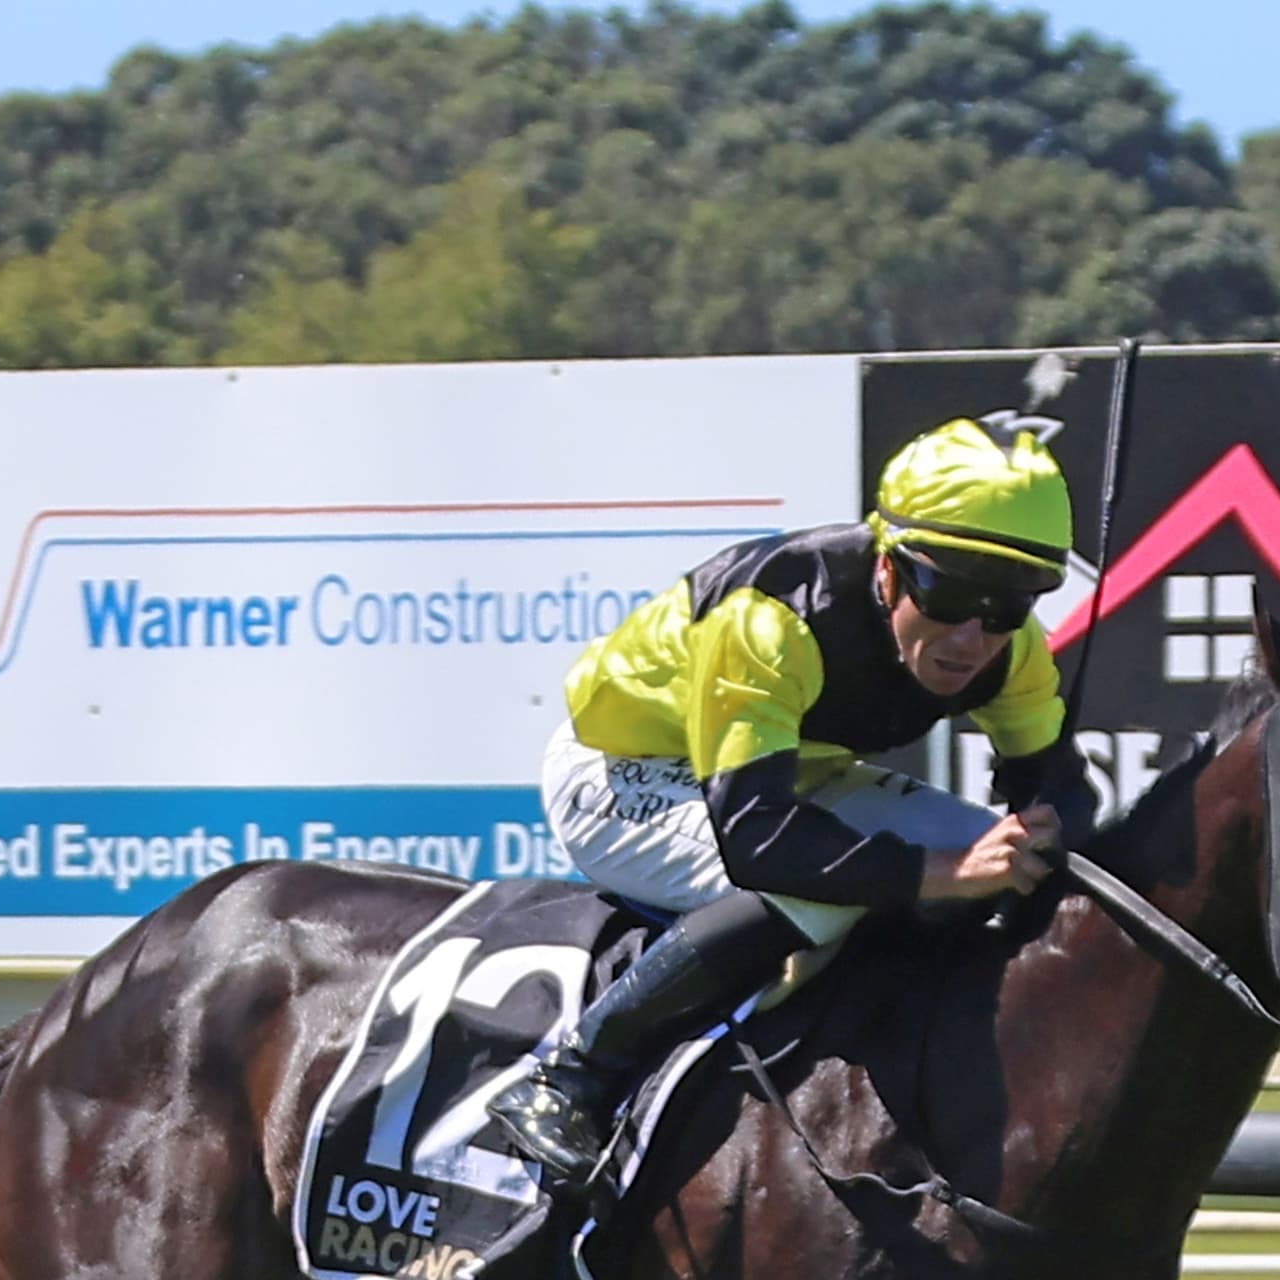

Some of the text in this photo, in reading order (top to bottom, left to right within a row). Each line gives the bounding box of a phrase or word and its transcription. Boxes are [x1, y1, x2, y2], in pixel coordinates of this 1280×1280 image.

[80, 578, 297, 649] Warner
[53, 822, 234, 890] Experts
[244, 821, 288, 860] In
[301, 820, 481, 880] Energy
[365, 936, 592, 1206] 12
[326, 1173, 441, 1238] LOVE
